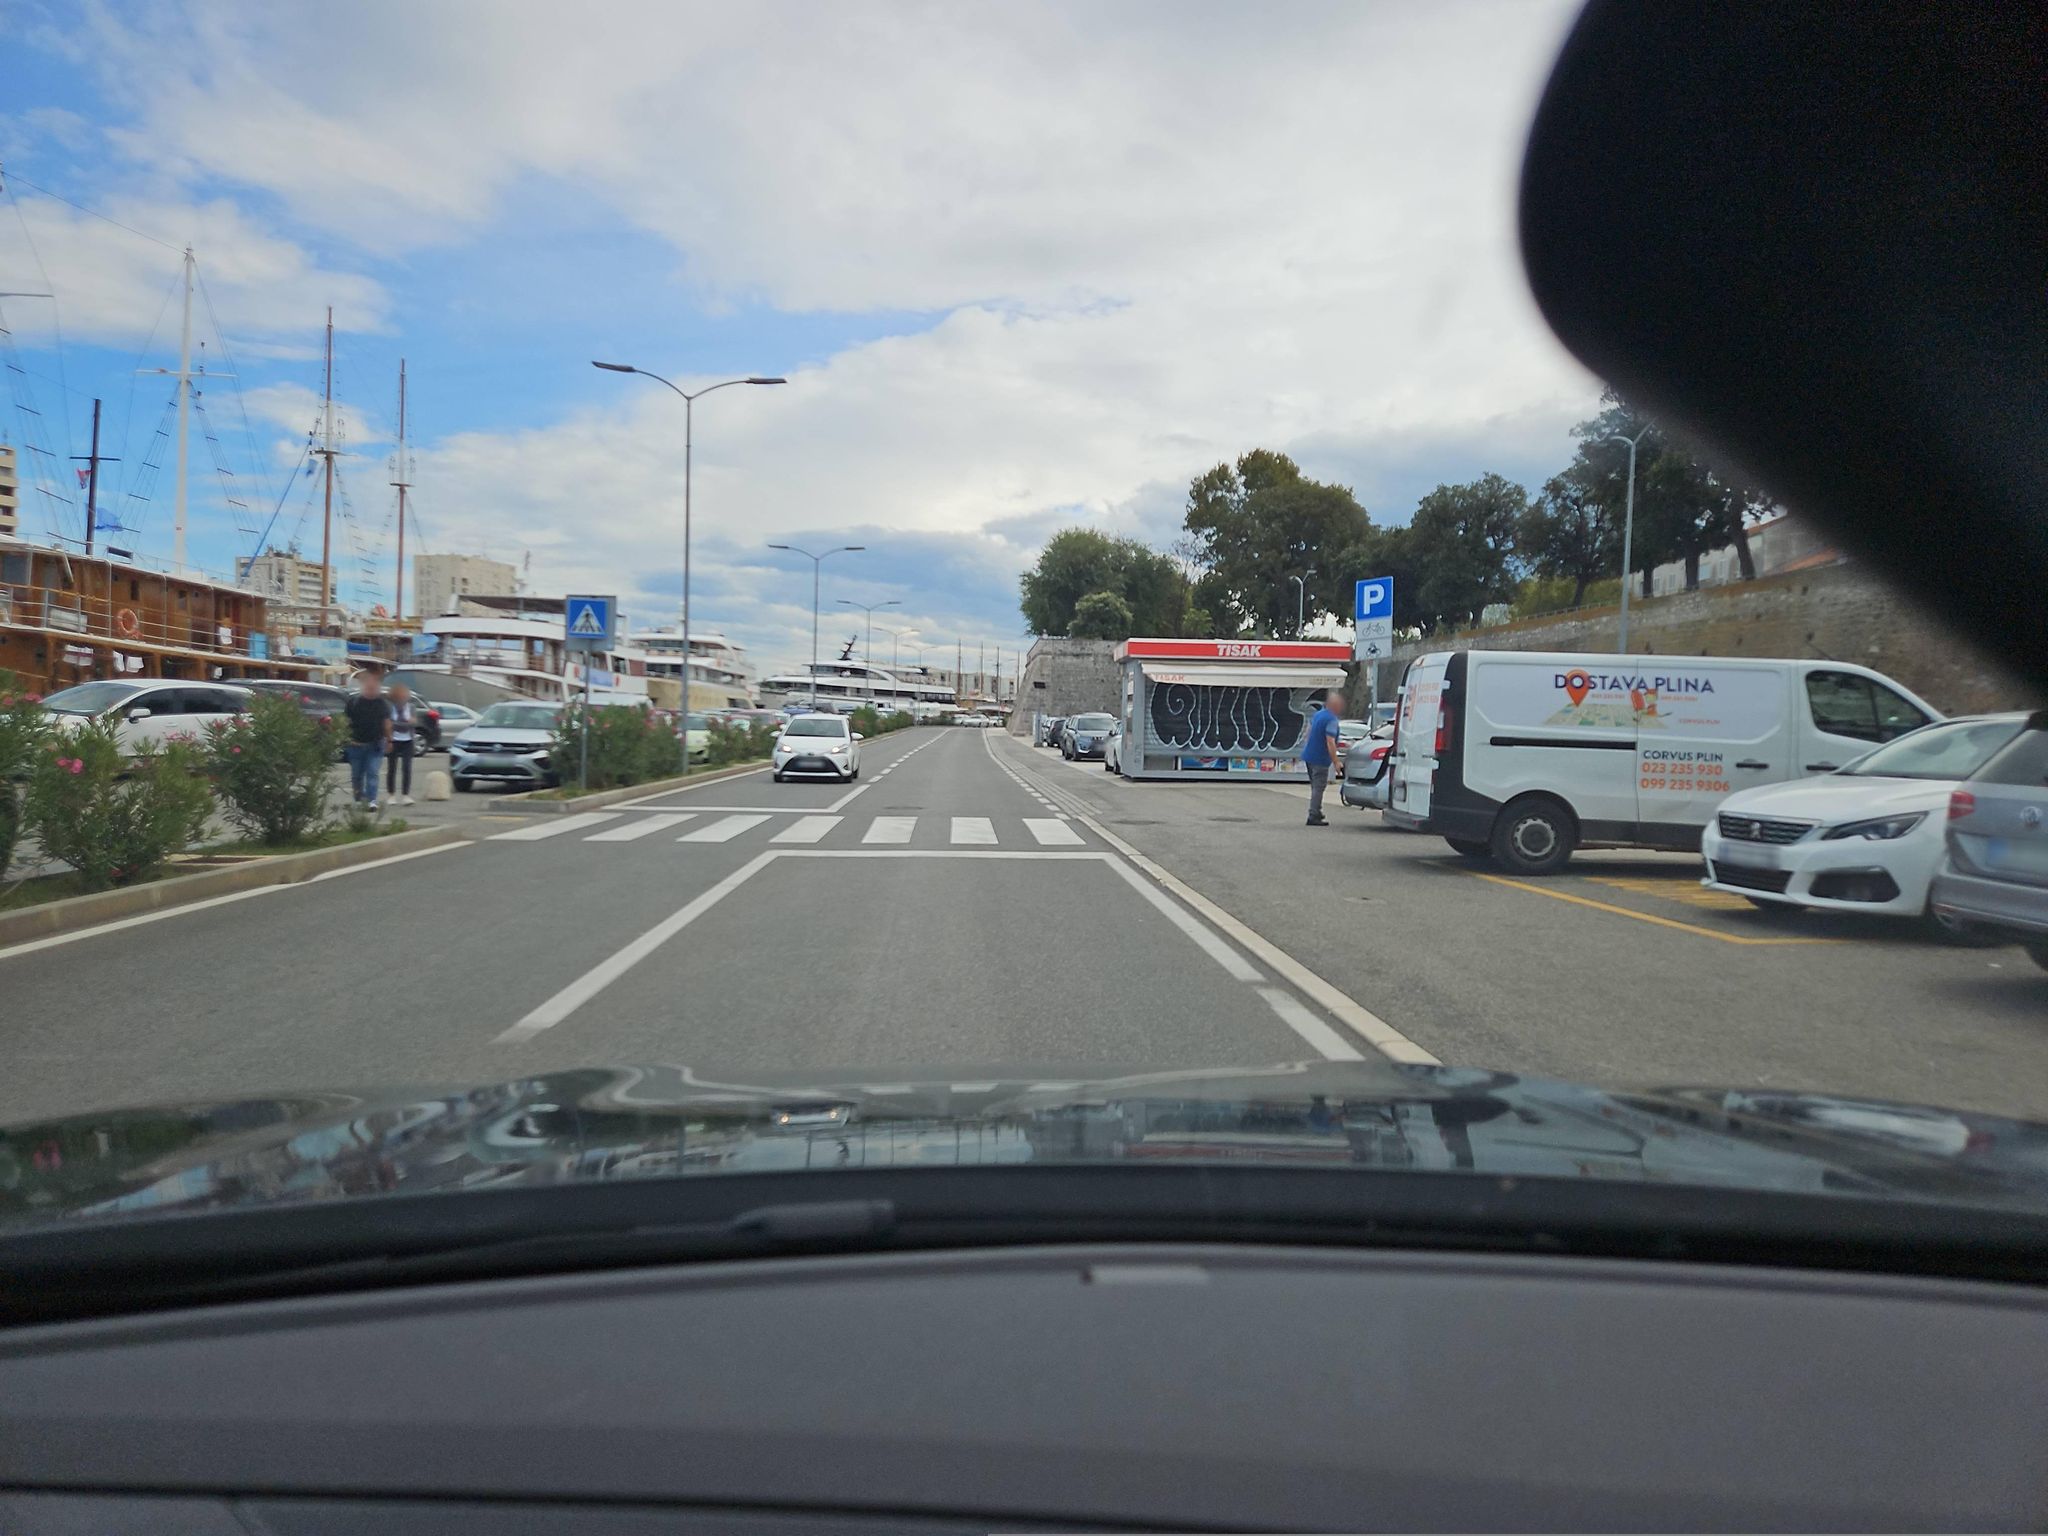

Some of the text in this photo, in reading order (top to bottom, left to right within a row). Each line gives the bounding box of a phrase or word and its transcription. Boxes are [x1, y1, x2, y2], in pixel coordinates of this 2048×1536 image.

[1363, 583, 1385, 615] P
[1216, 644, 1262, 657] TISAK
[1554, 674, 1714, 693] DOSTAVA PLINA
[1643, 750, 1723, 762] CORVUS PLIN
[1642, 762, 1723, 776] 023 235 930
[1640, 778, 1729, 792] 099 235 9306
